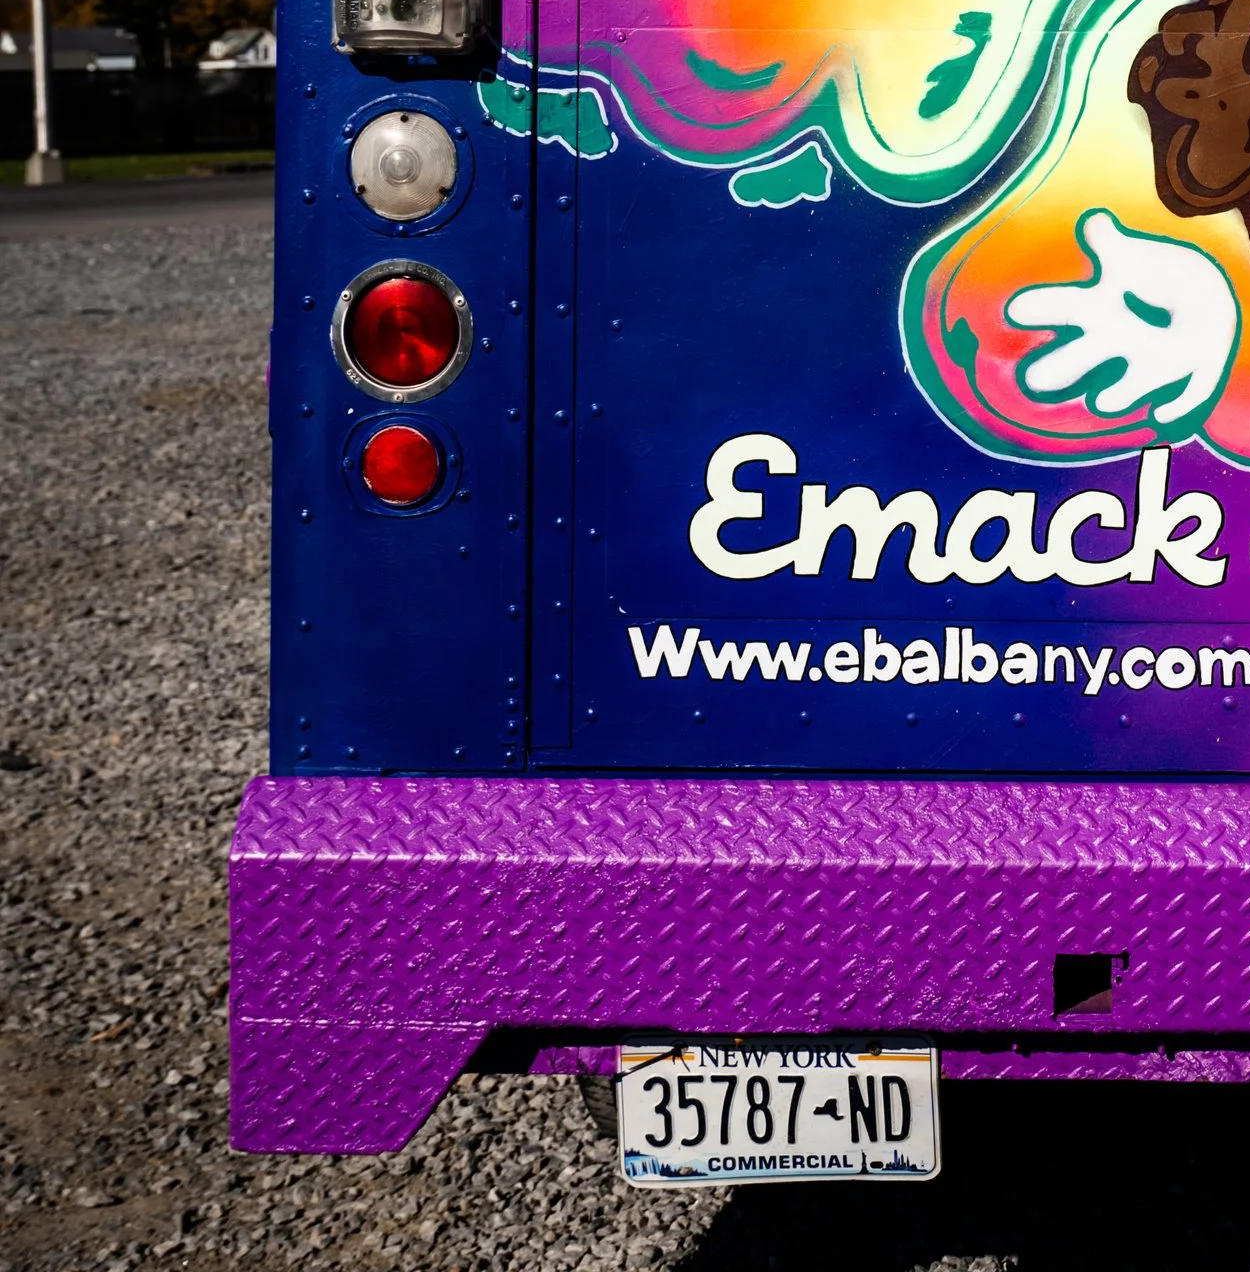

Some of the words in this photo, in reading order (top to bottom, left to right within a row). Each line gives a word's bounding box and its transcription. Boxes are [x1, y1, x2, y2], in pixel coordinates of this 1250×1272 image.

[688, 432, 1230, 588] Emack
[698, 1043, 768, 1068] NEW
[774, 1043, 857, 1068] YORK
[642, 1074, 806, 1148] 35787
[848, 1074, 913, 1144] ND
[708, 1153, 854, 1173] COMMERCIAL
